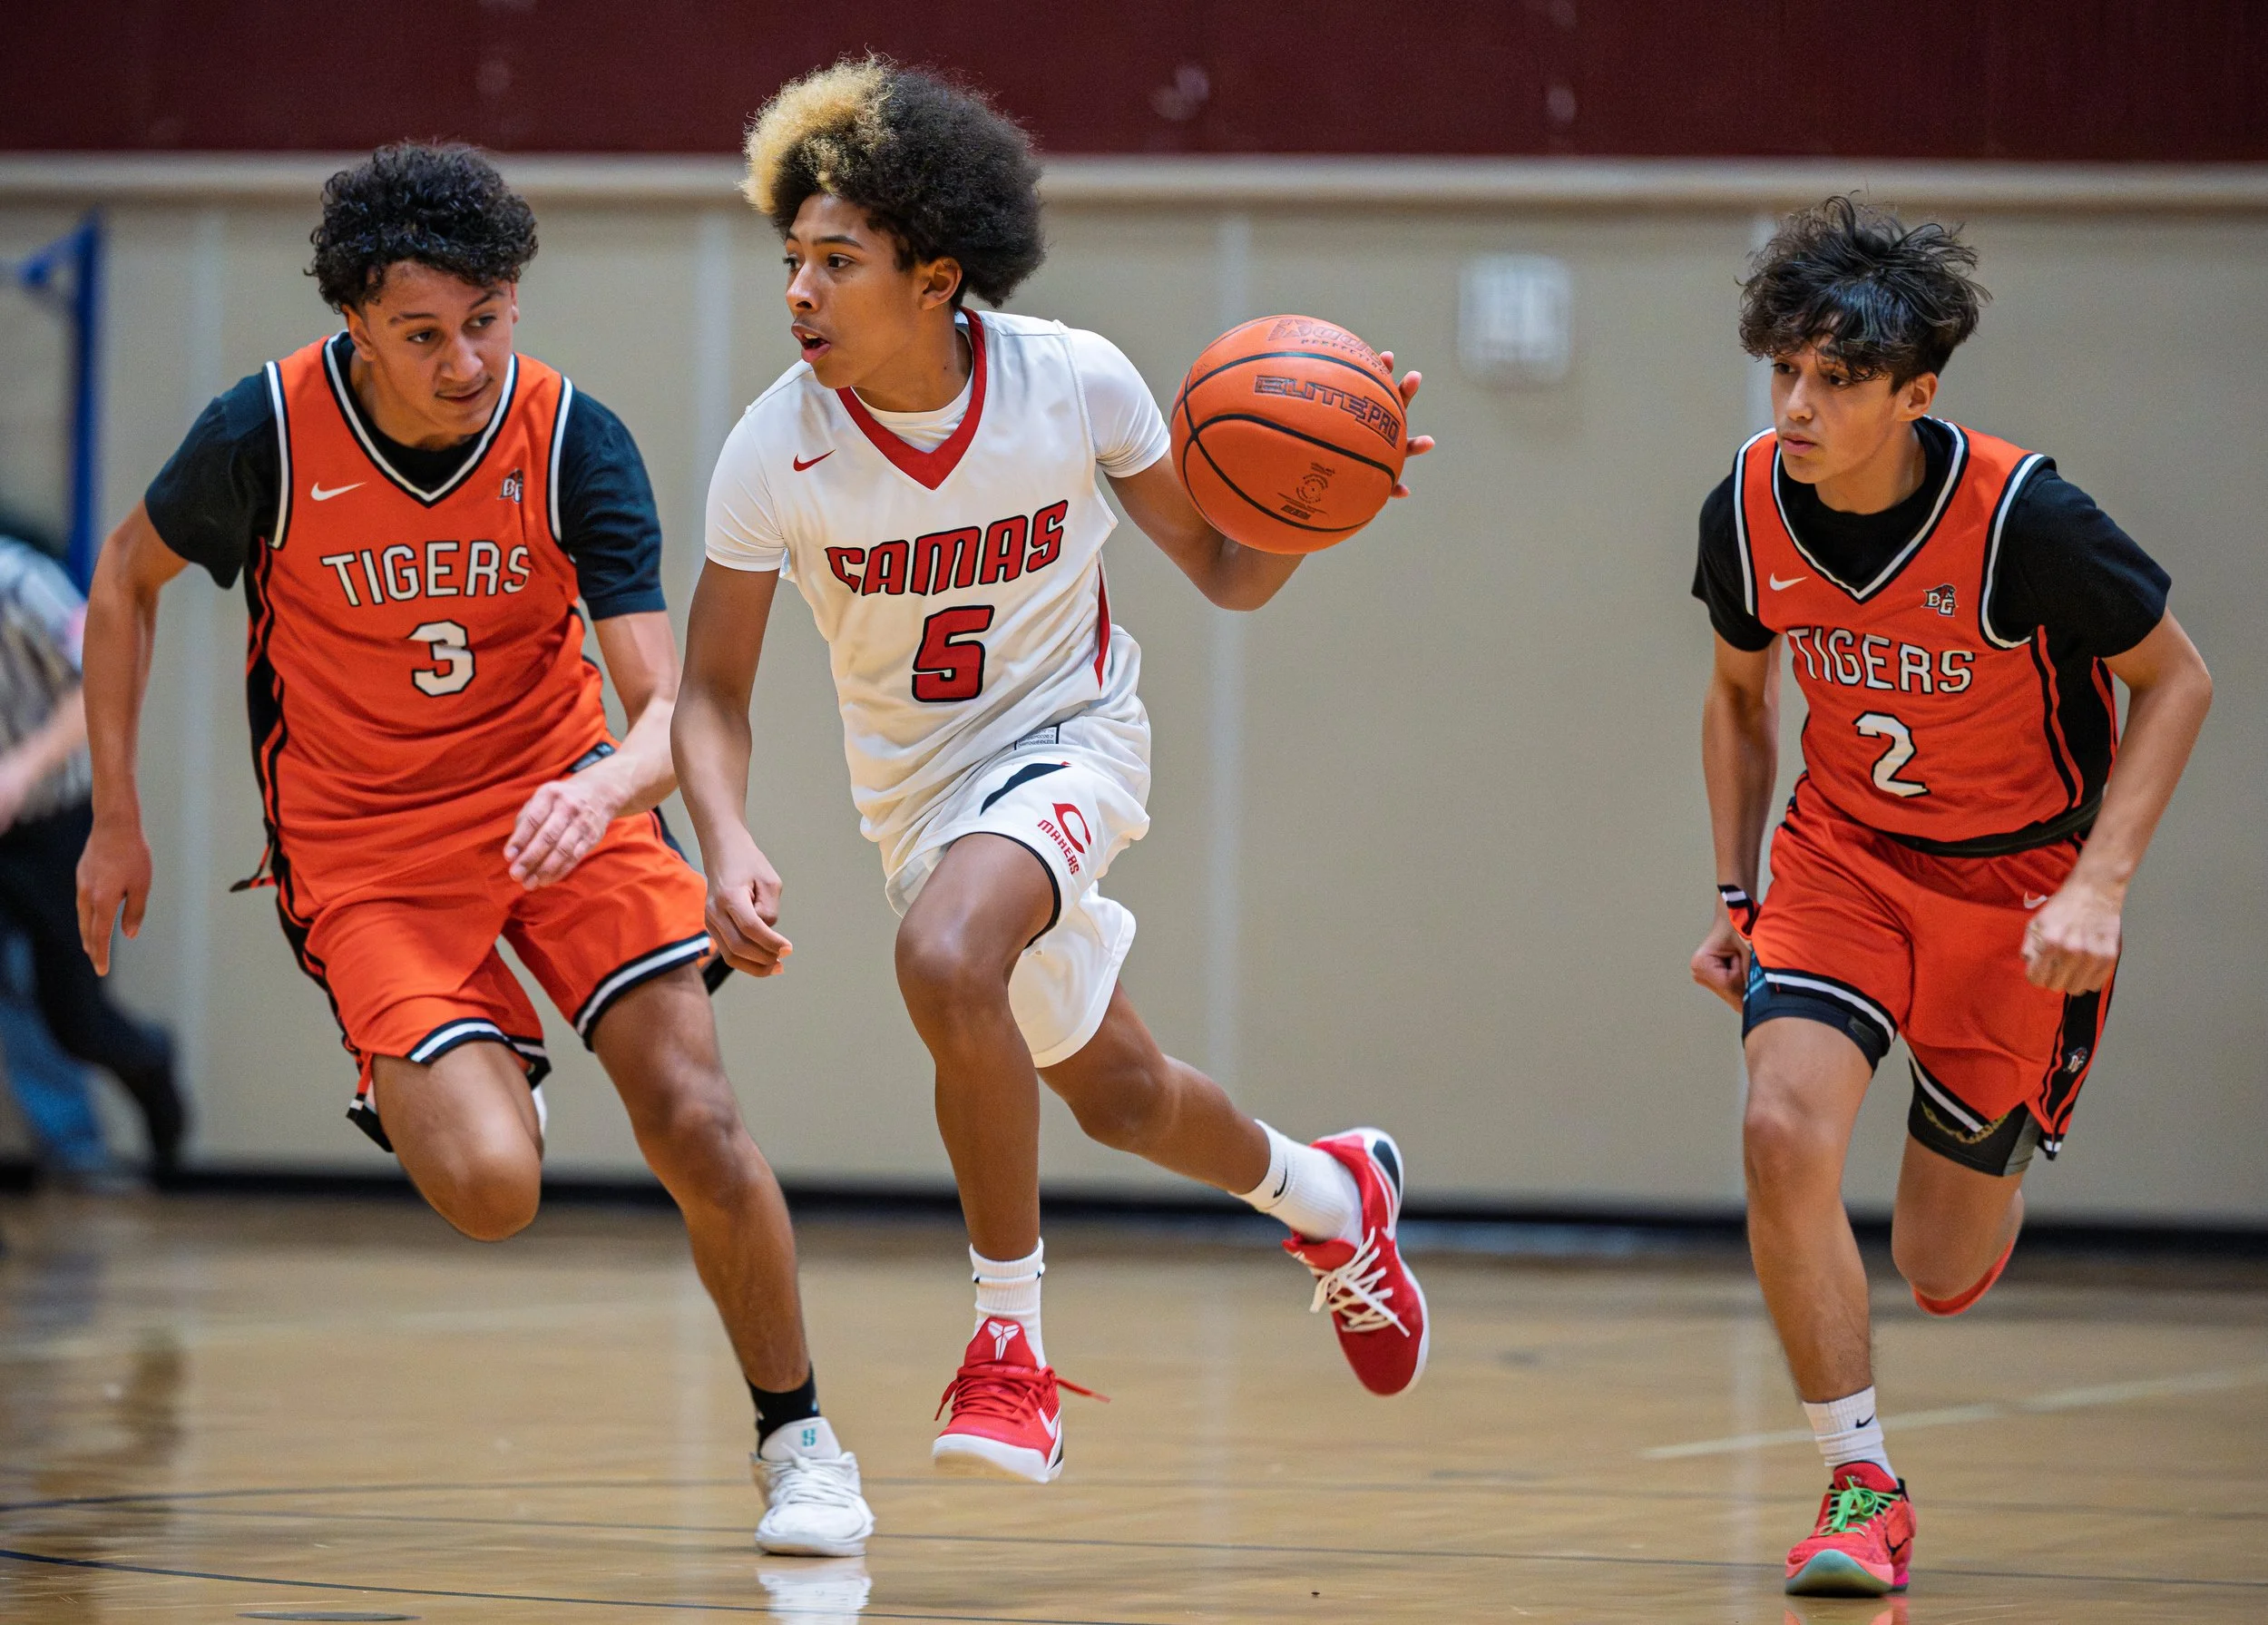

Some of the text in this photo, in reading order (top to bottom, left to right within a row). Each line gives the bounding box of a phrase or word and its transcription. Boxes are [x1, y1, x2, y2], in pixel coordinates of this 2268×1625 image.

[1254, 375, 1400, 445] ELITE PRO
[320, 541, 532, 606] TIGERS
[824, 499, 1069, 596] CAMAS
[1927, 592, 1956, 616] BG
[406, 619, 476, 697] 3
[912, 605, 995, 702] 5
[1786, 625, 1976, 694] TIGERS
[1853, 710, 1931, 798] 2
